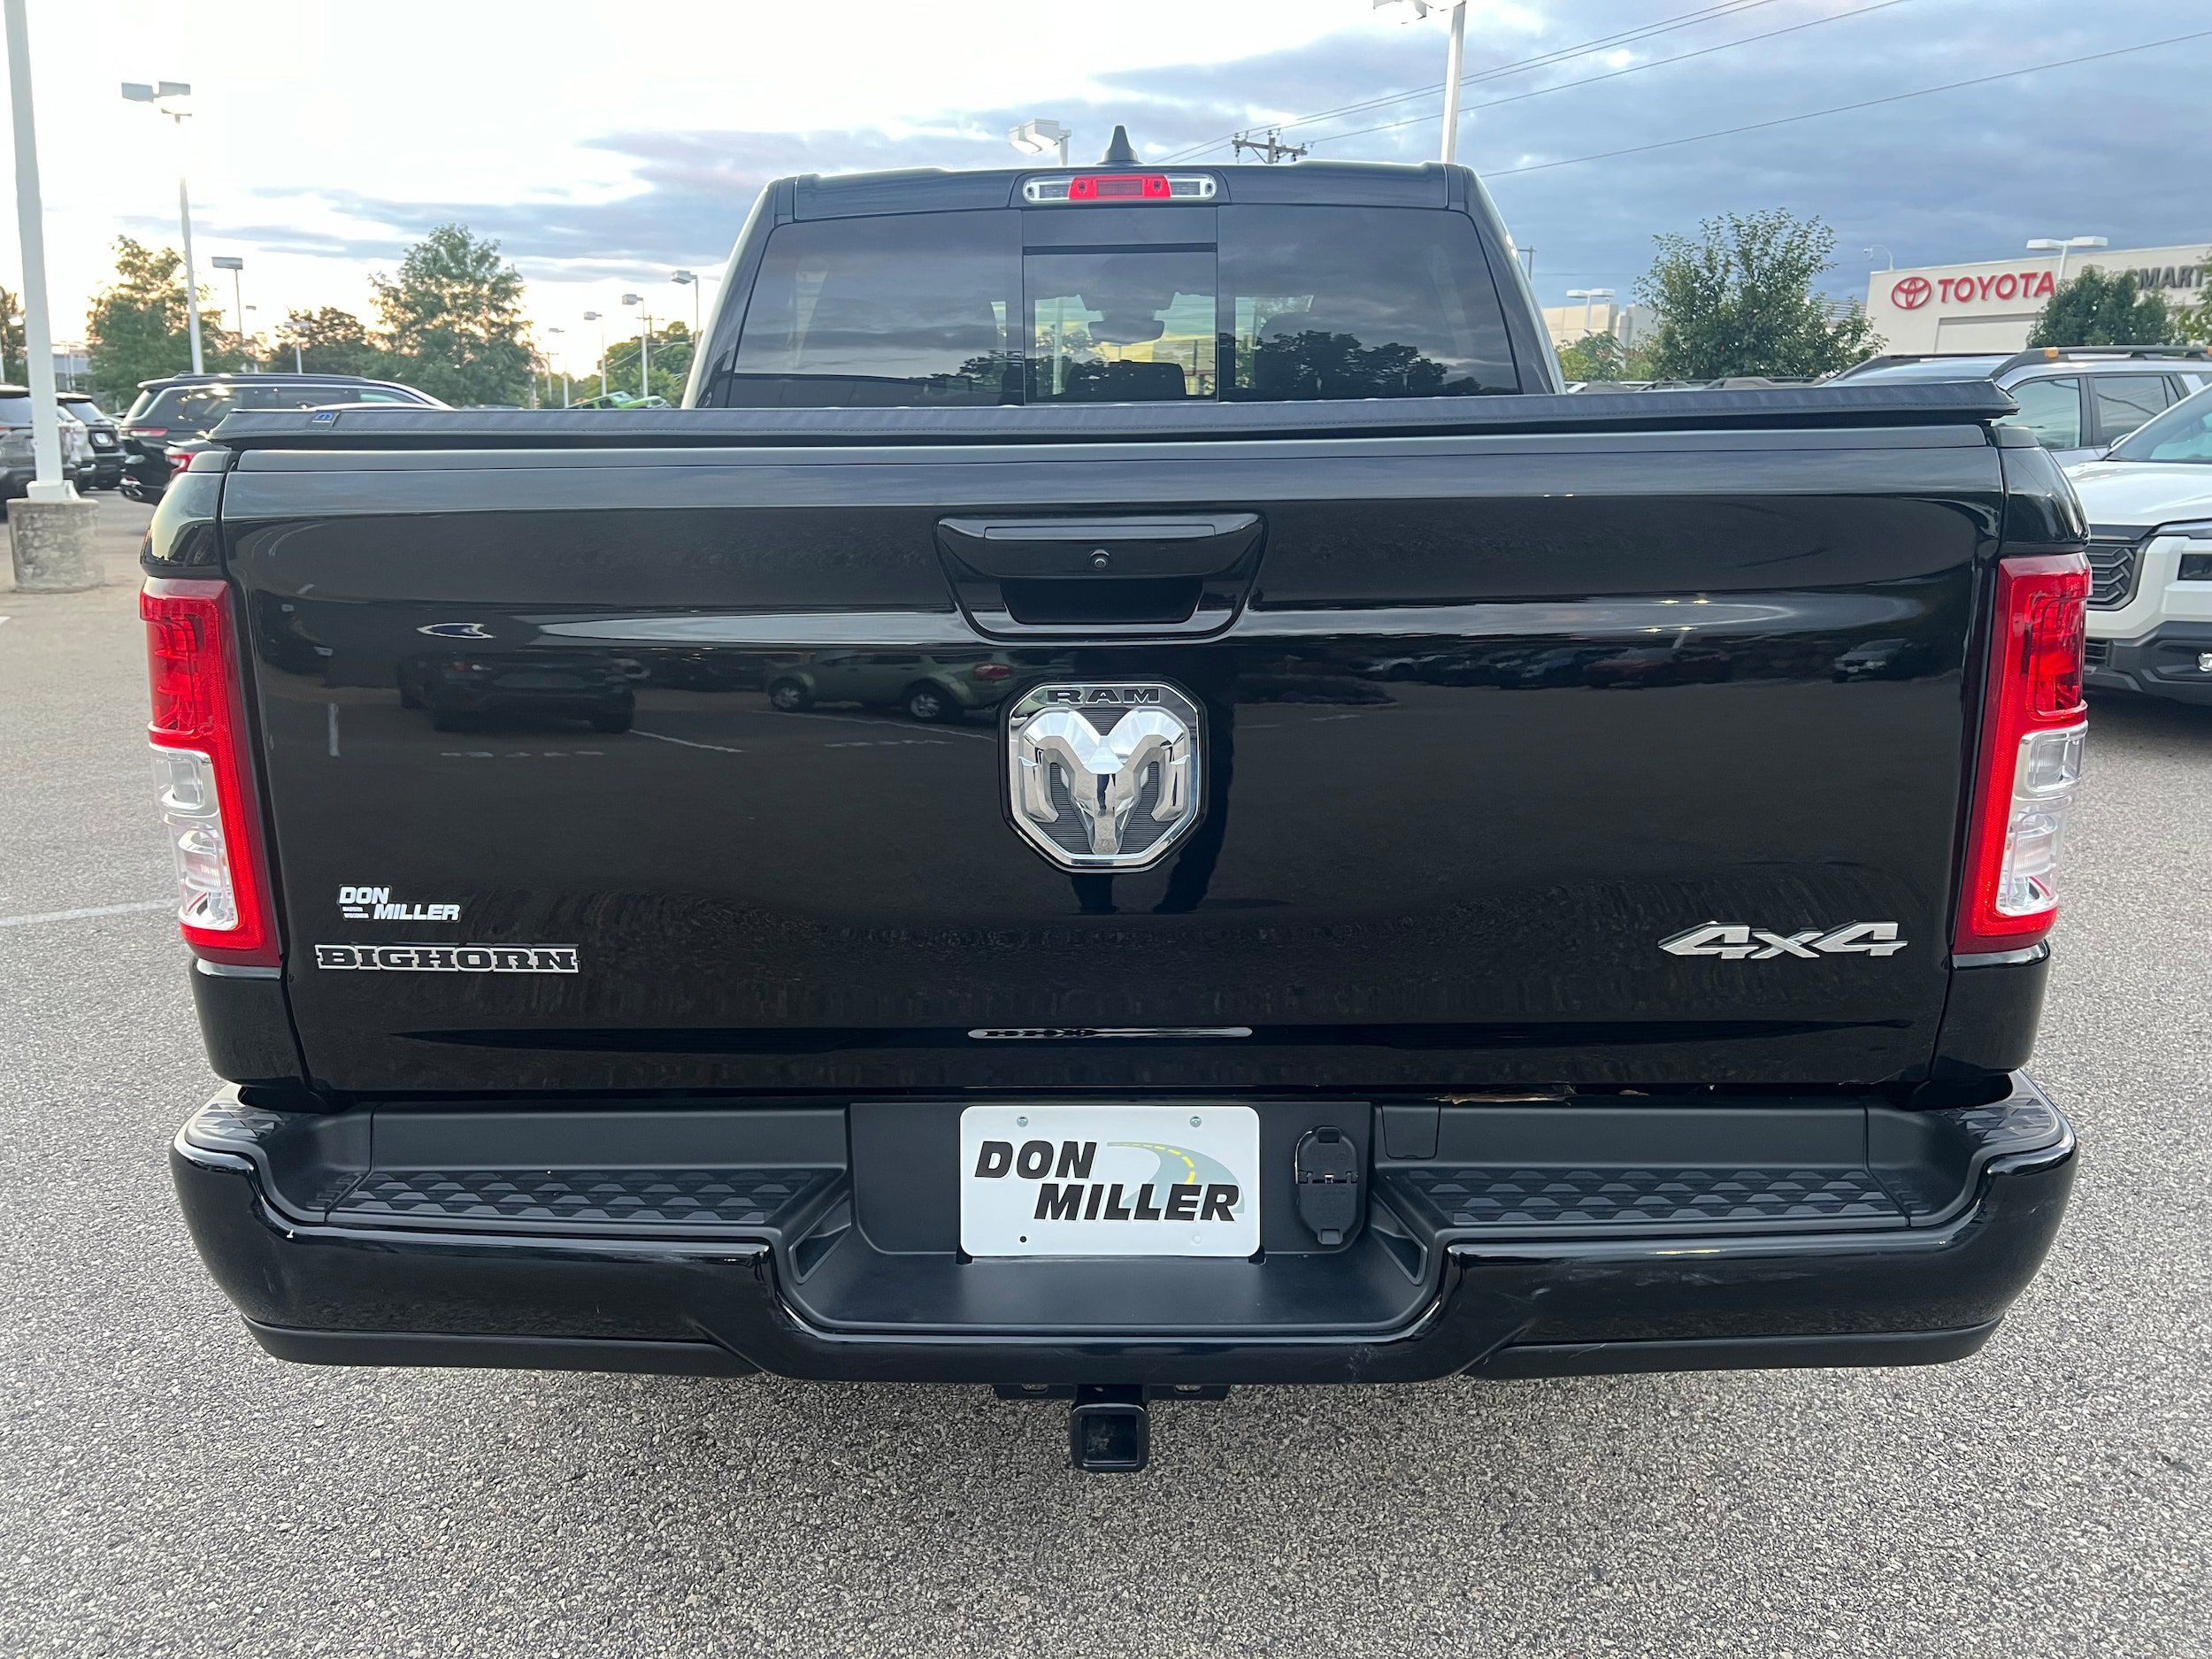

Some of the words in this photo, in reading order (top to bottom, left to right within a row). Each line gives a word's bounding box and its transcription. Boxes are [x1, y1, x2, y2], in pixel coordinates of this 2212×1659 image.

[1938, 271, 2055, 303] TOYOTA
[1046, 688, 1160, 704] RAM
[339, 887, 390, 904] DON
[373, 903, 461, 921] MILLER
[314, 944, 580, 973] BIGHORN
[974, 1141, 1098, 1179] DON
[1033, 1183, 1240, 1222] MILLER
